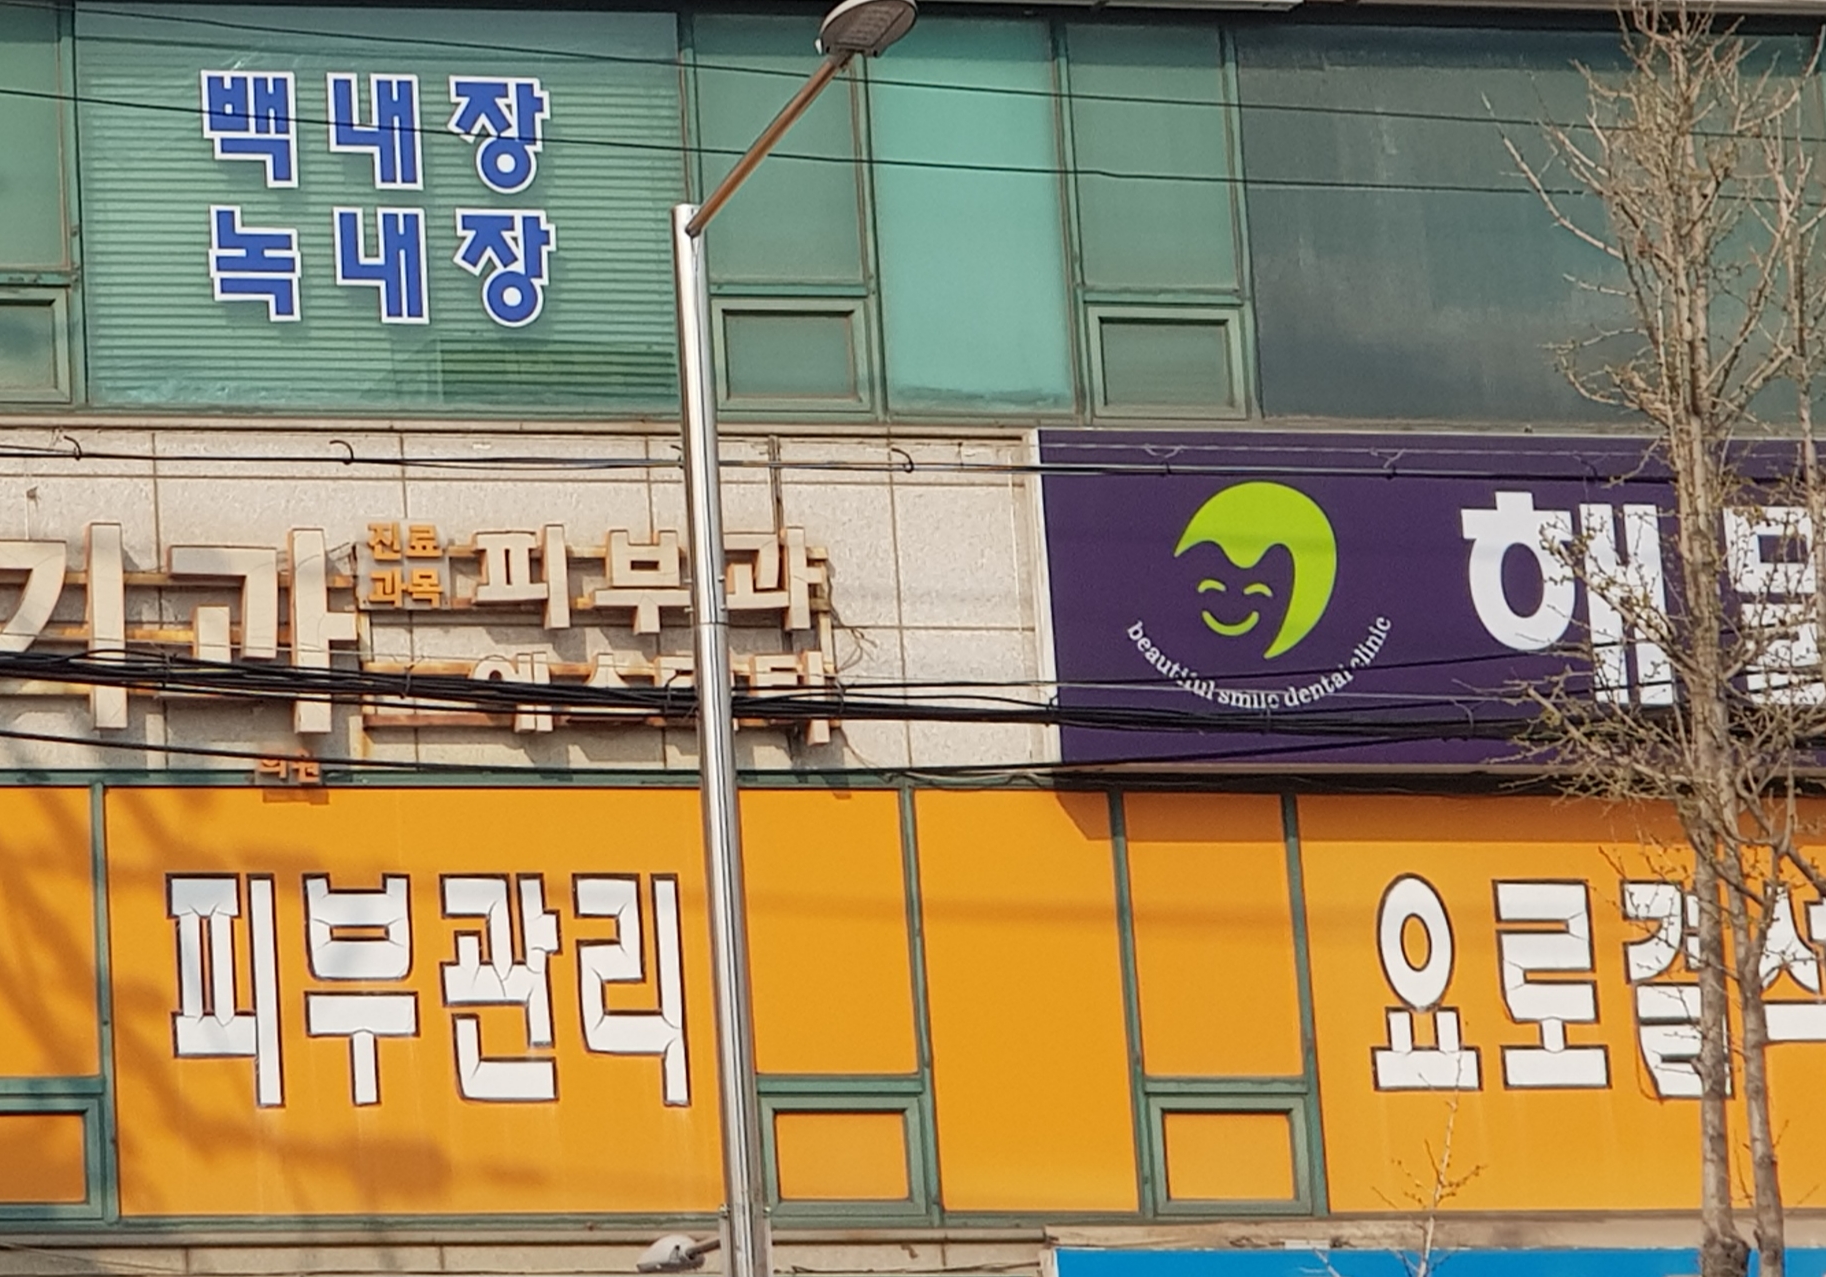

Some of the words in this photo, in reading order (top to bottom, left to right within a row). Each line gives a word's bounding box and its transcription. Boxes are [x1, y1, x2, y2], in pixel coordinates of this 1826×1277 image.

[200, 69, 550, 193] 백내장
[208, 205, 556, 326] 녹내장
[367, 521, 443, 559] 진료
[367, 567, 444, 608] 과목
[473, 524, 827, 634] 피부과
[1349, 615, 1392, 670] clinic
[166, 873, 691, 1108] 피부관리
